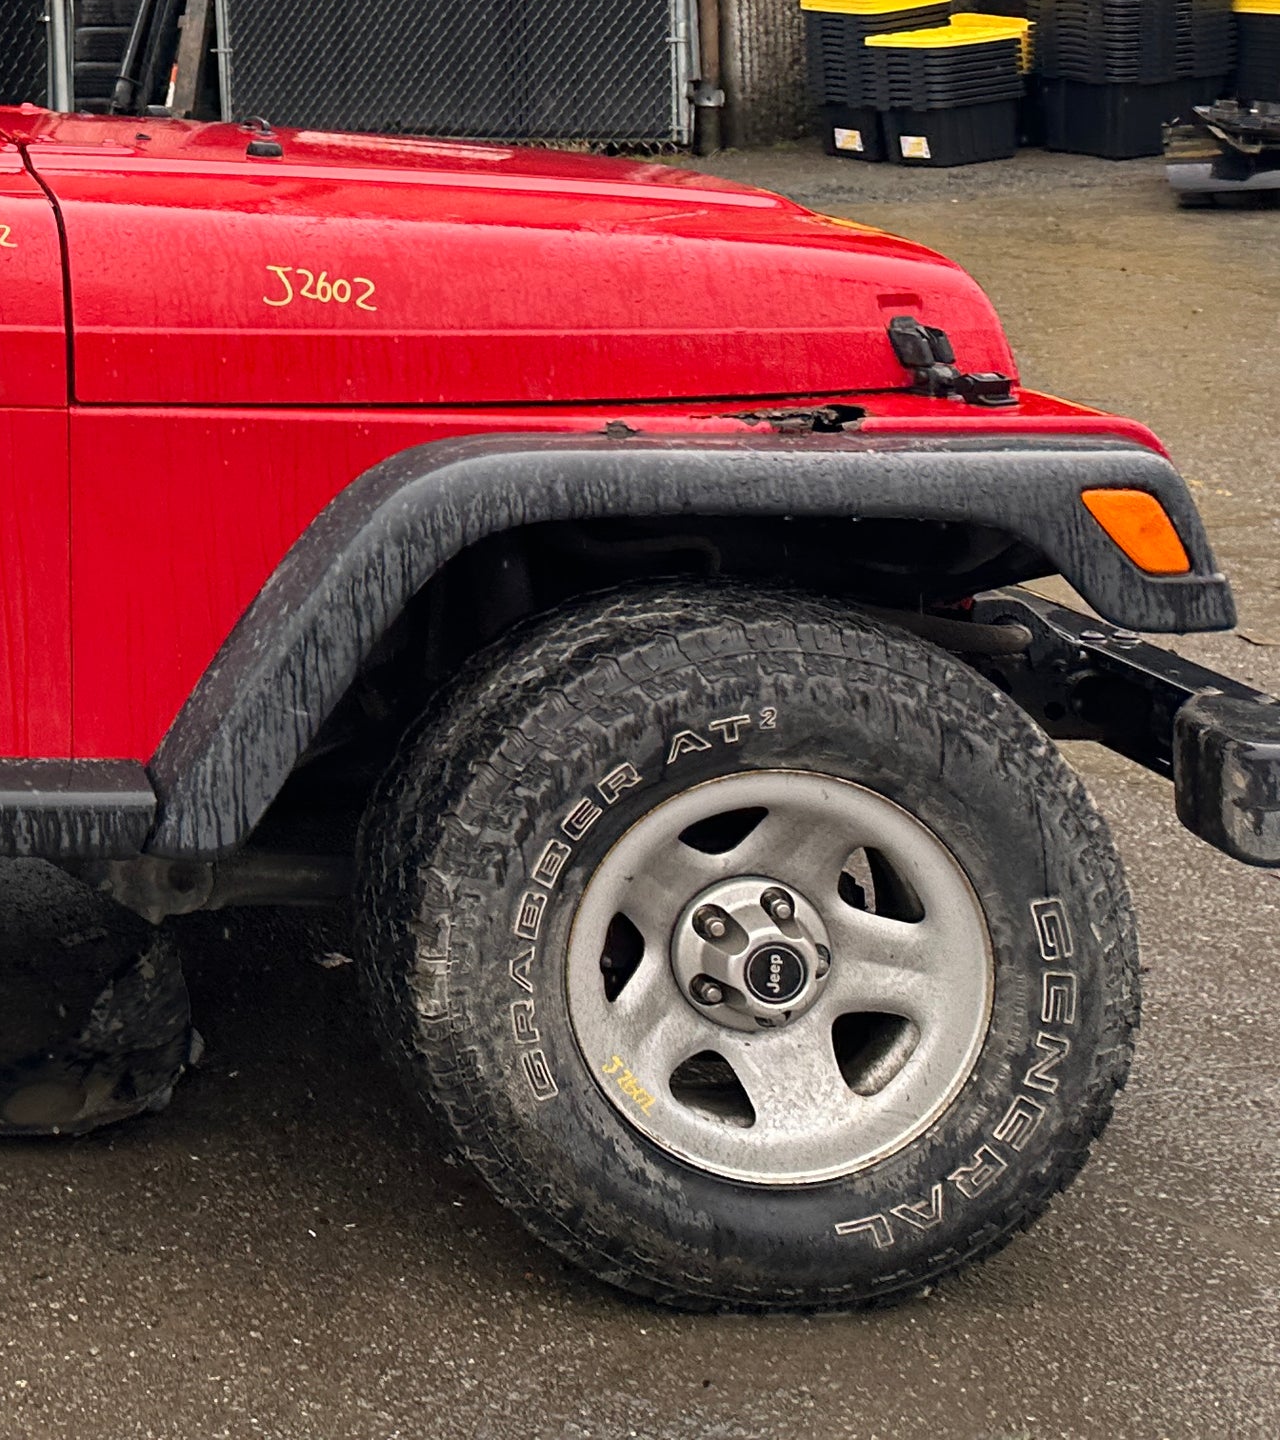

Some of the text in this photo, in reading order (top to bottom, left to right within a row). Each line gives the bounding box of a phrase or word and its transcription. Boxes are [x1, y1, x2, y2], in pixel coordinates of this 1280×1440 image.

[263, 265, 377, 311] J2602
[510, 763, 643, 1102] GRABBER
[766, 954, 784, 993] Jeep
[835, 898, 1078, 1248] GENERAL
